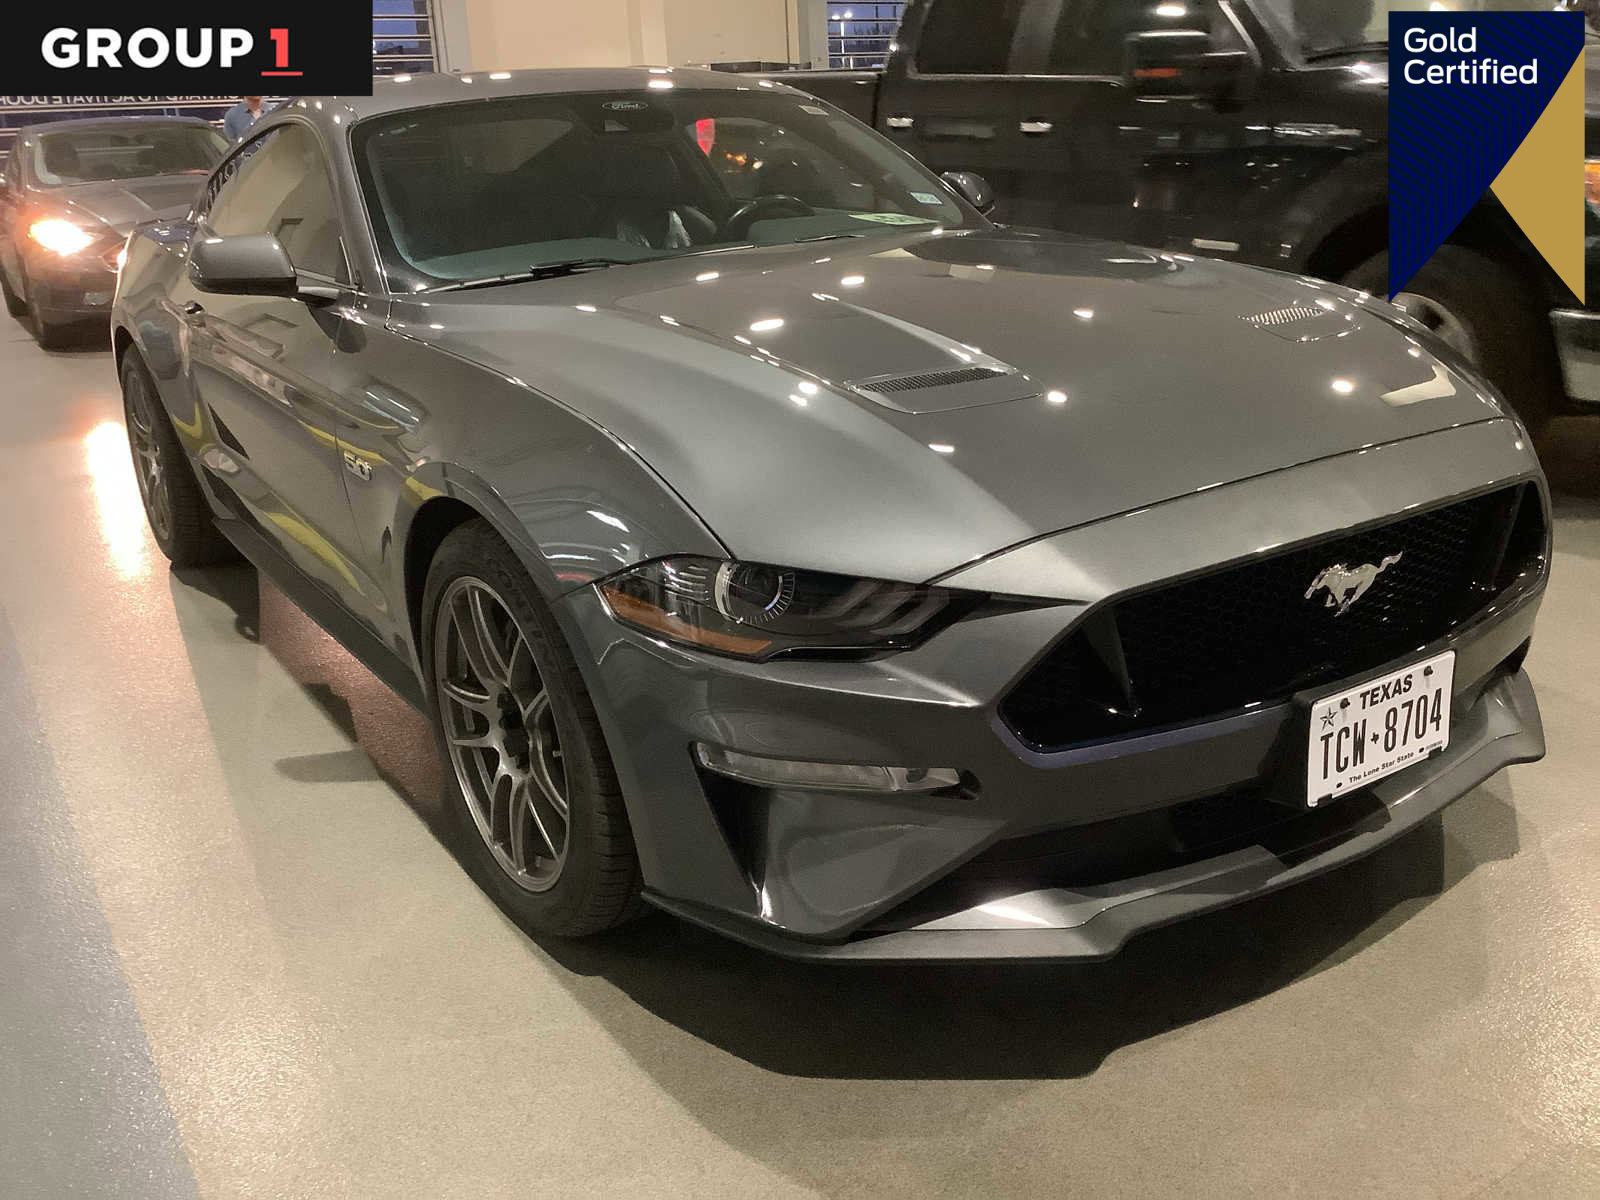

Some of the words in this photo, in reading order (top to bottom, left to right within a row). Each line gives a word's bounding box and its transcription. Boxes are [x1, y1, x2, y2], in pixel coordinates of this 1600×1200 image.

[1360, 674, 1412, 710] TEXAS
[1320, 718, 1367, 780] TCW
[1383, 688, 1442, 753] 8704
[1349, 775, 1362, 783] The
[1363, 767, 1380, 778] Lone
[1381, 759, 1395, 770] Star
[1397, 752, 1414, 762] State
